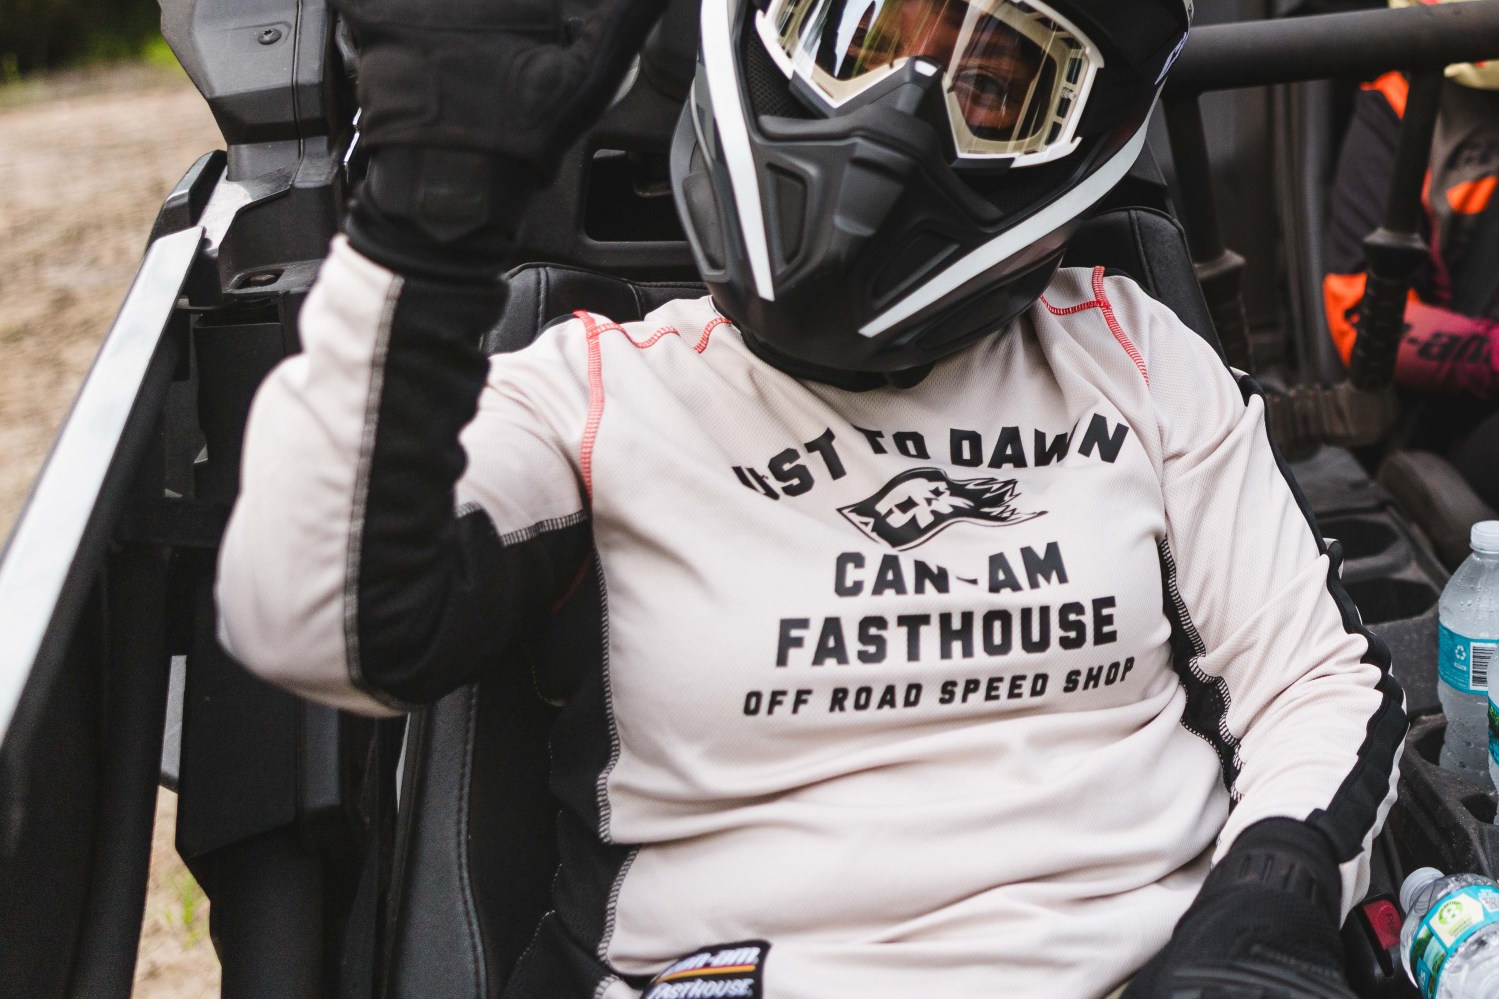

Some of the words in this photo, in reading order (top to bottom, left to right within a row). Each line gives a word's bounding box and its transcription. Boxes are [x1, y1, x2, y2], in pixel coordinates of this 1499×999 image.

[852, 425, 931, 460] TO
[949, 412, 1130, 469] DAWN
[833, 541, 1069, 598] CAN-AM
[775, 595, 1119, 667] FASTHOUSE
[743, 690, 812, 716] OFF
[828, 684, 923, 713] ROAD
[938, 673, 1048, 705] SPEED
[1062, 656, 1135, 693] SHOP
